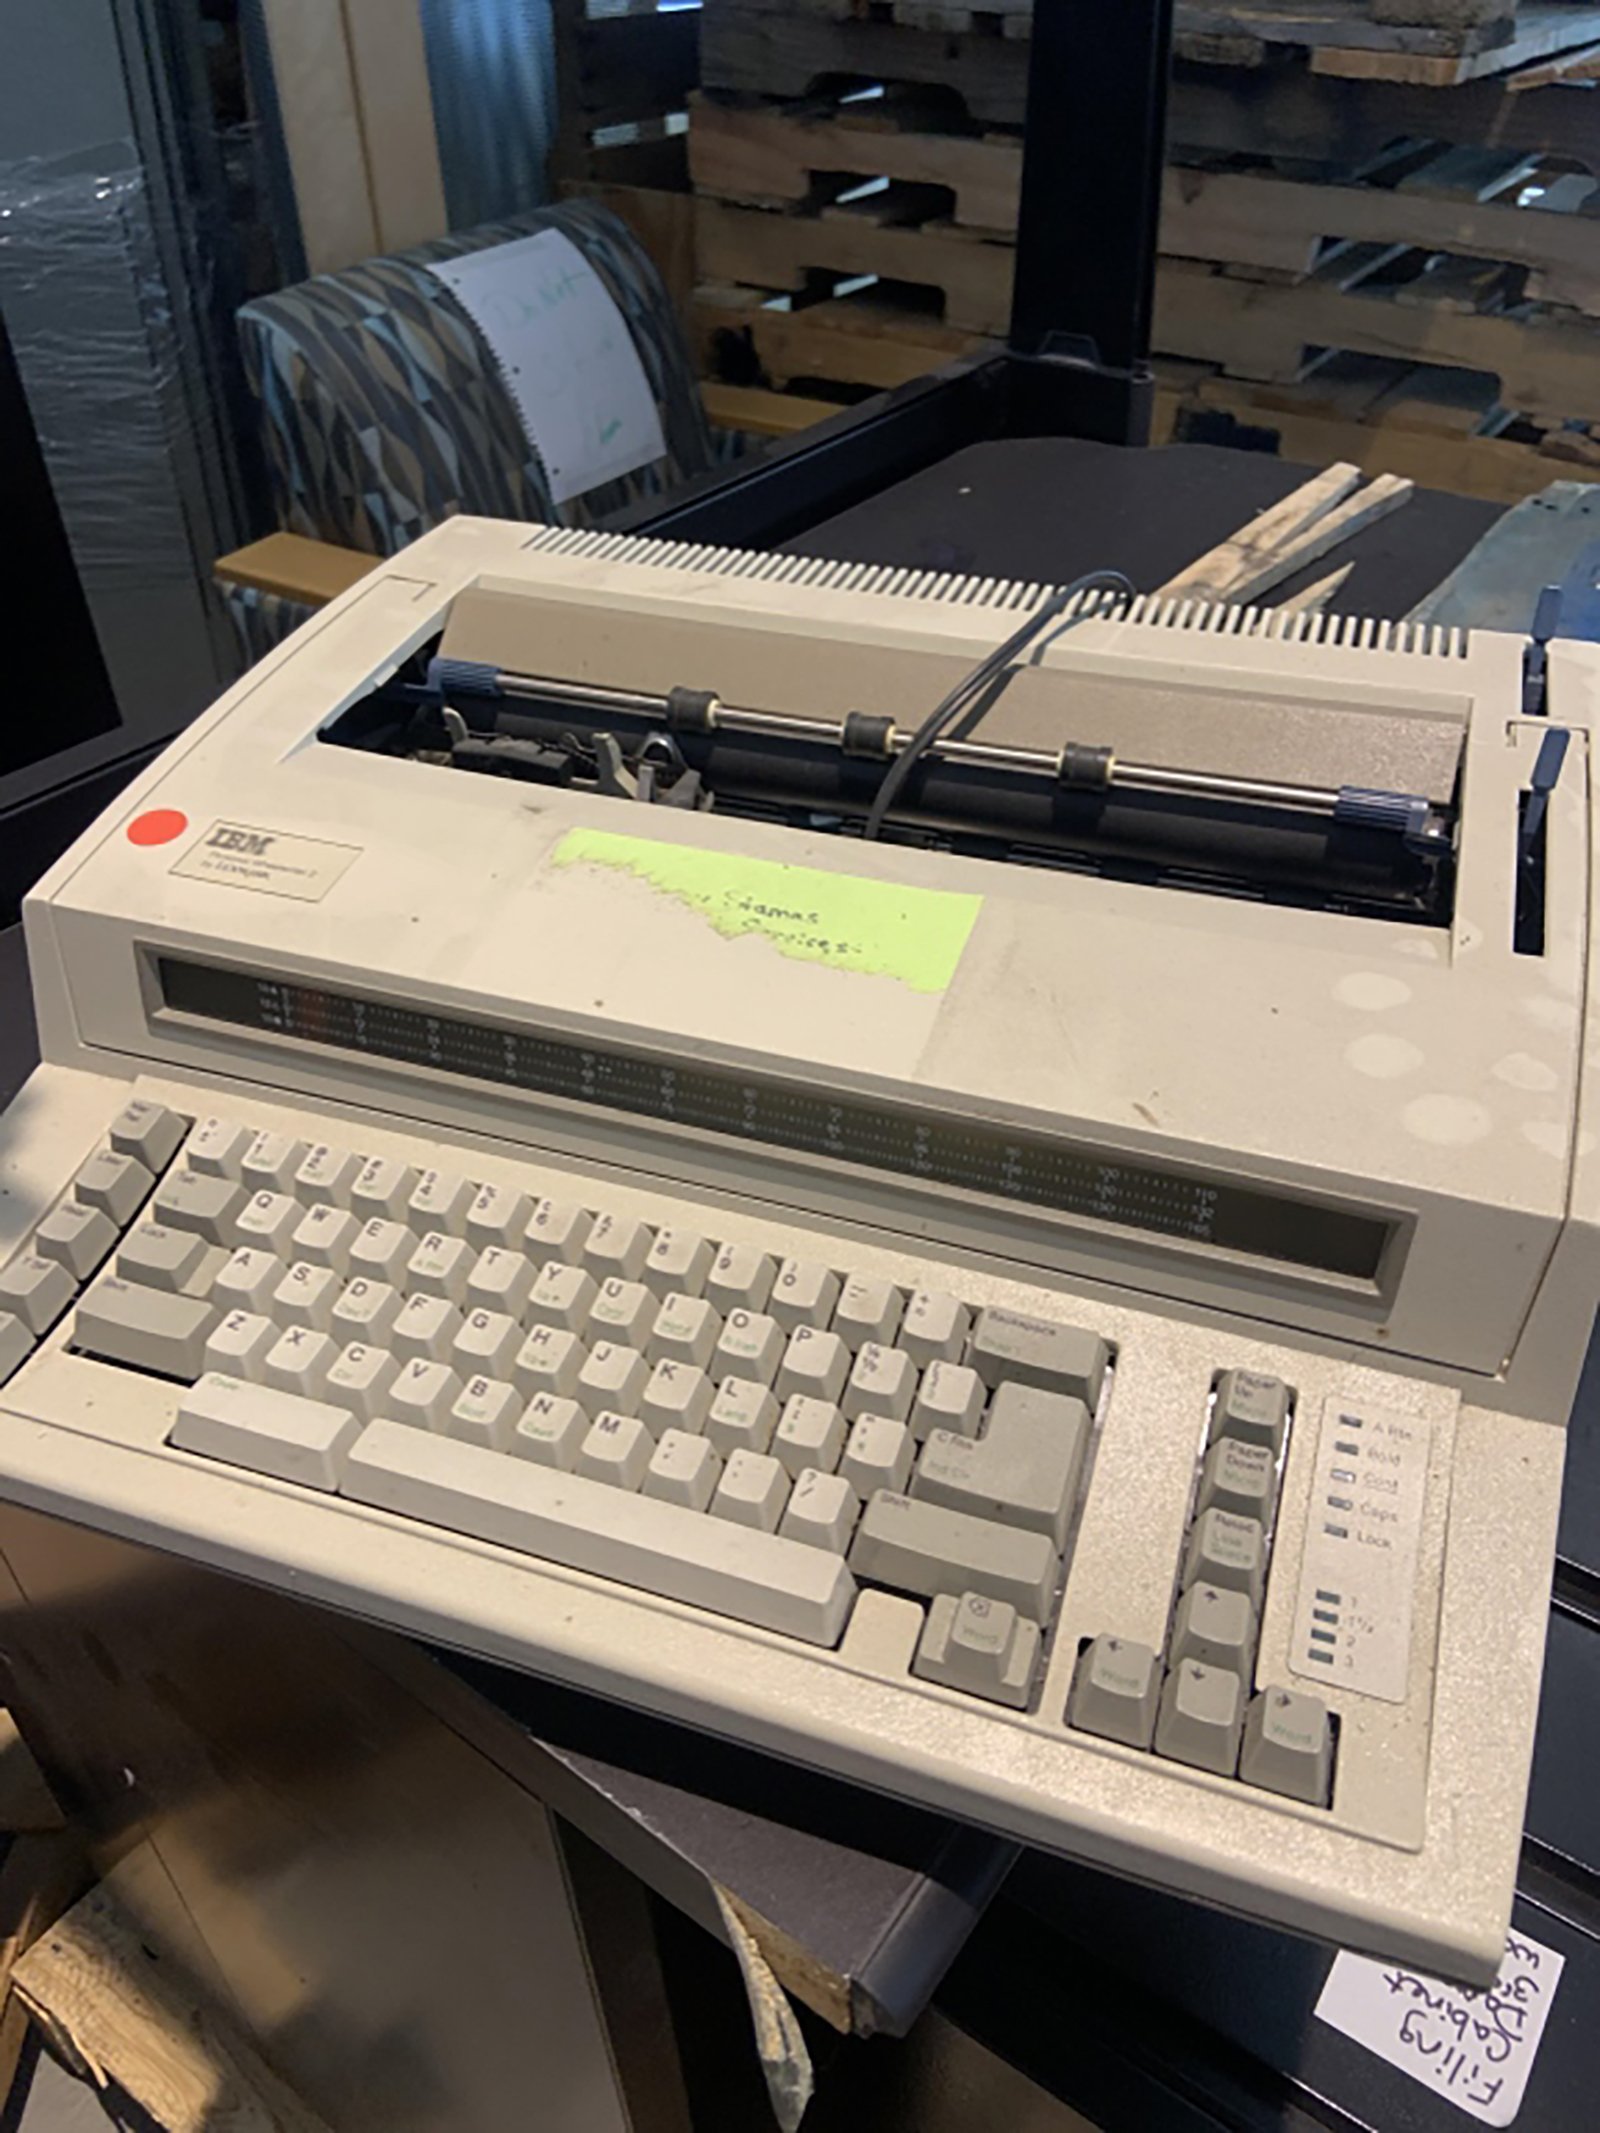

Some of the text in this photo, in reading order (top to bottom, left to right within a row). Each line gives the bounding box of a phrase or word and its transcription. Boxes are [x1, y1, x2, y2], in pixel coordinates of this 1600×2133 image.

[205, 827, 275, 855] IBM
[256, 1192, 274, 1210] Q
[311, 1206, 331, 1222] W
[365, 1221, 384, 1237] E
[423, 1235, 443, 1252] R
[234, 1252, 252, 1267] A
[486, 1249, 501, 1265] T
[292, 1266, 311, 1282] S
[546, 1266, 562, 1281] Y
[349, 1281, 368, 1298] D
[604, 1280, 623, 1298] U
[409, 1296, 428, 1311] F
[666, 1296, 677, 1312] I
[226, 1314, 247, 1332] Z
[471, 1312, 489, 1329] G
[732, 1312, 749, 1330] O
[285, 1330, 306, 1346] X
[532, 1329, 552, 1345] H
[796, 1328, 813, 1344] P
[347, 1346, 366, 1362] C
[595, 1347, 612, 1362] J
[411, 1363, 429, 1379] V
[659, 1363, 679, 1381] K
[470, 1380, 489, 1398] B
[724, 1380, 739, 1398] L
[533, 1399, 554, 1415] N
[598, 1416, 621, 1434] M
[1383, 1971, 1511, 2062] Cabinet
[1399, 2009, 1503, 2105] Filing
